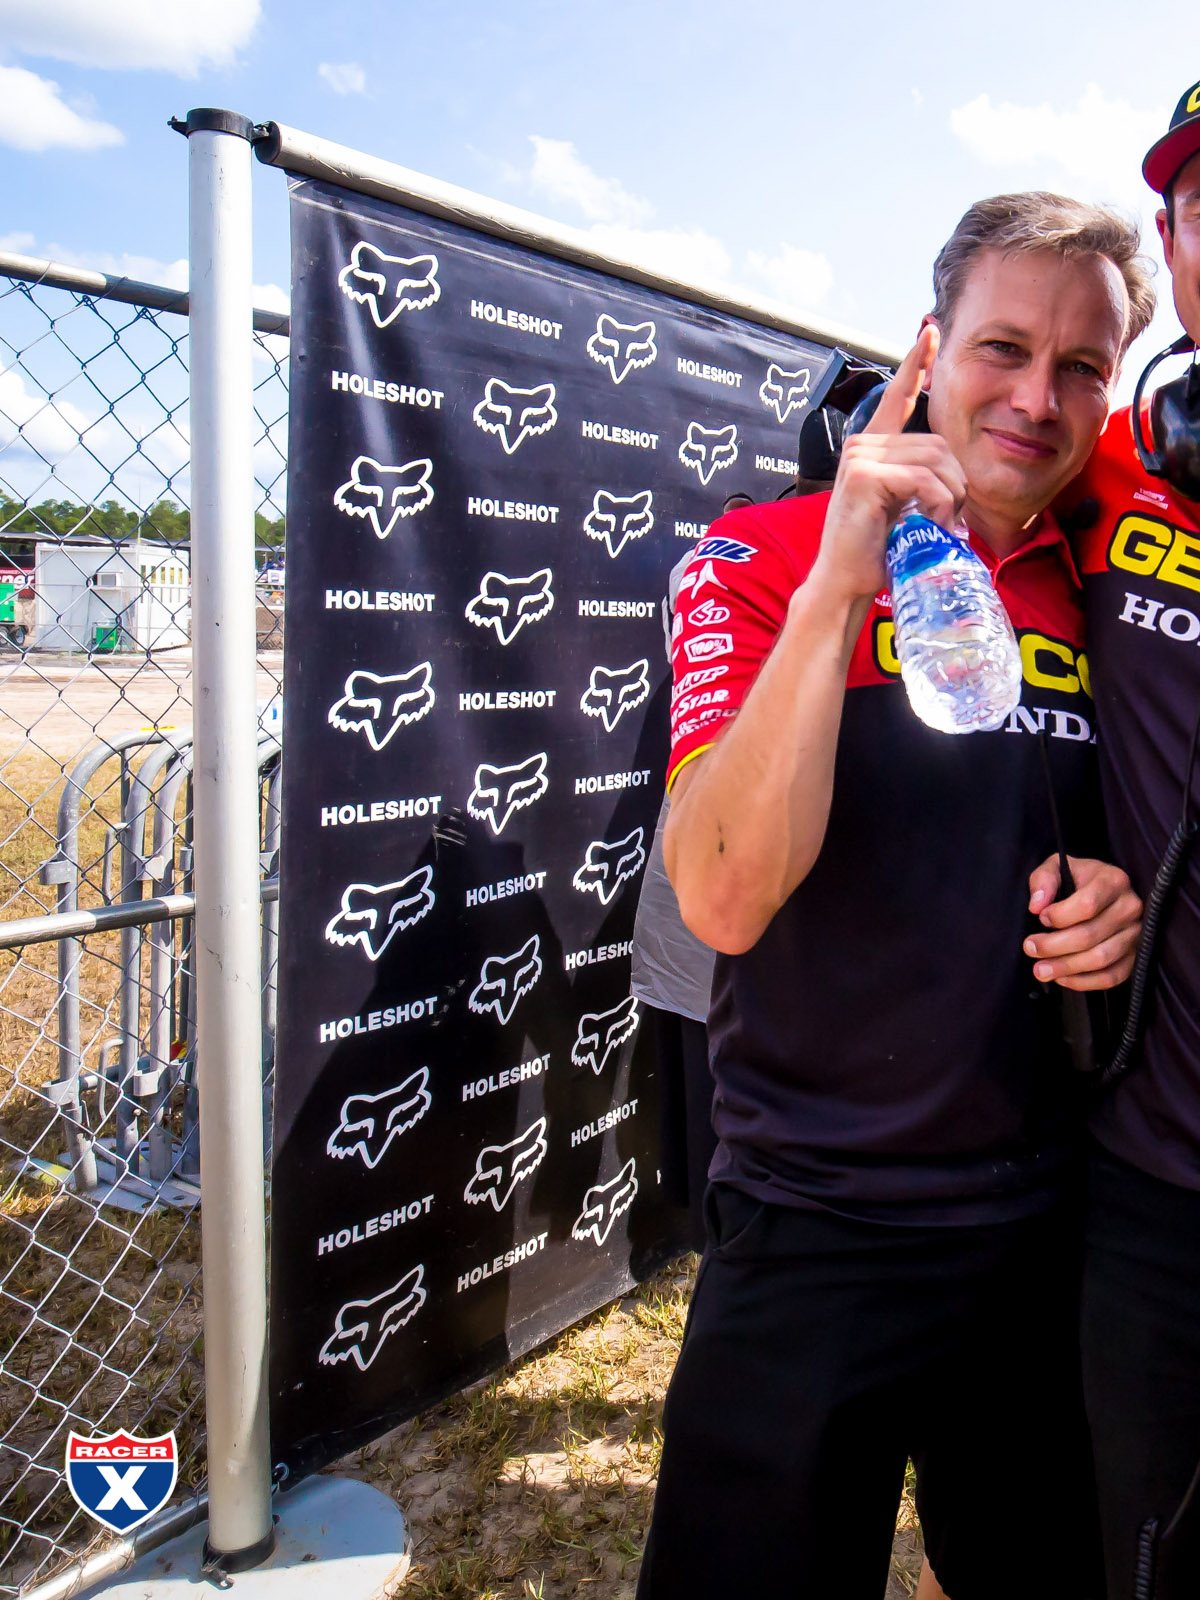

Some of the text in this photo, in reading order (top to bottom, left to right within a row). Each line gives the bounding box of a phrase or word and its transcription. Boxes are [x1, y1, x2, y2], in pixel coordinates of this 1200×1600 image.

[470, 299, 563, 340] HOLESHOT
[677, 357, 743, 388] HOLESHOT
[331, 370, 445, 409] HOLESHOT
[582, 420, 659, 450] HOLESHOT
[755, 454, 800, 476] HOLESH
[467, 496, 560, 524] HOLESHOT
[674, 521, 710, 539] HOLE
[325, 589, 436, 612] HOLESHOT
[578, 599, 656, 618] HOLESHOT
[689, 638, 728, 657] 100%
[459, 690, 557, 711] HOLESHOT
[574, 769, 651, 795] HOLESHOT
[321, 795, 442, 827] HOLESHOT
[466, 871, 547, 907] HOLESHOT
[319, 996, 438, 1044] HOLESHOT
[462, 1053, 551, 1102] HOLESHOT
[571, 1098, 638, 1148] HOLESHOT
[318, 1194, 434, 1256] HOLESHOT
[457, 1231, 549, 1293] HOLESHOT
